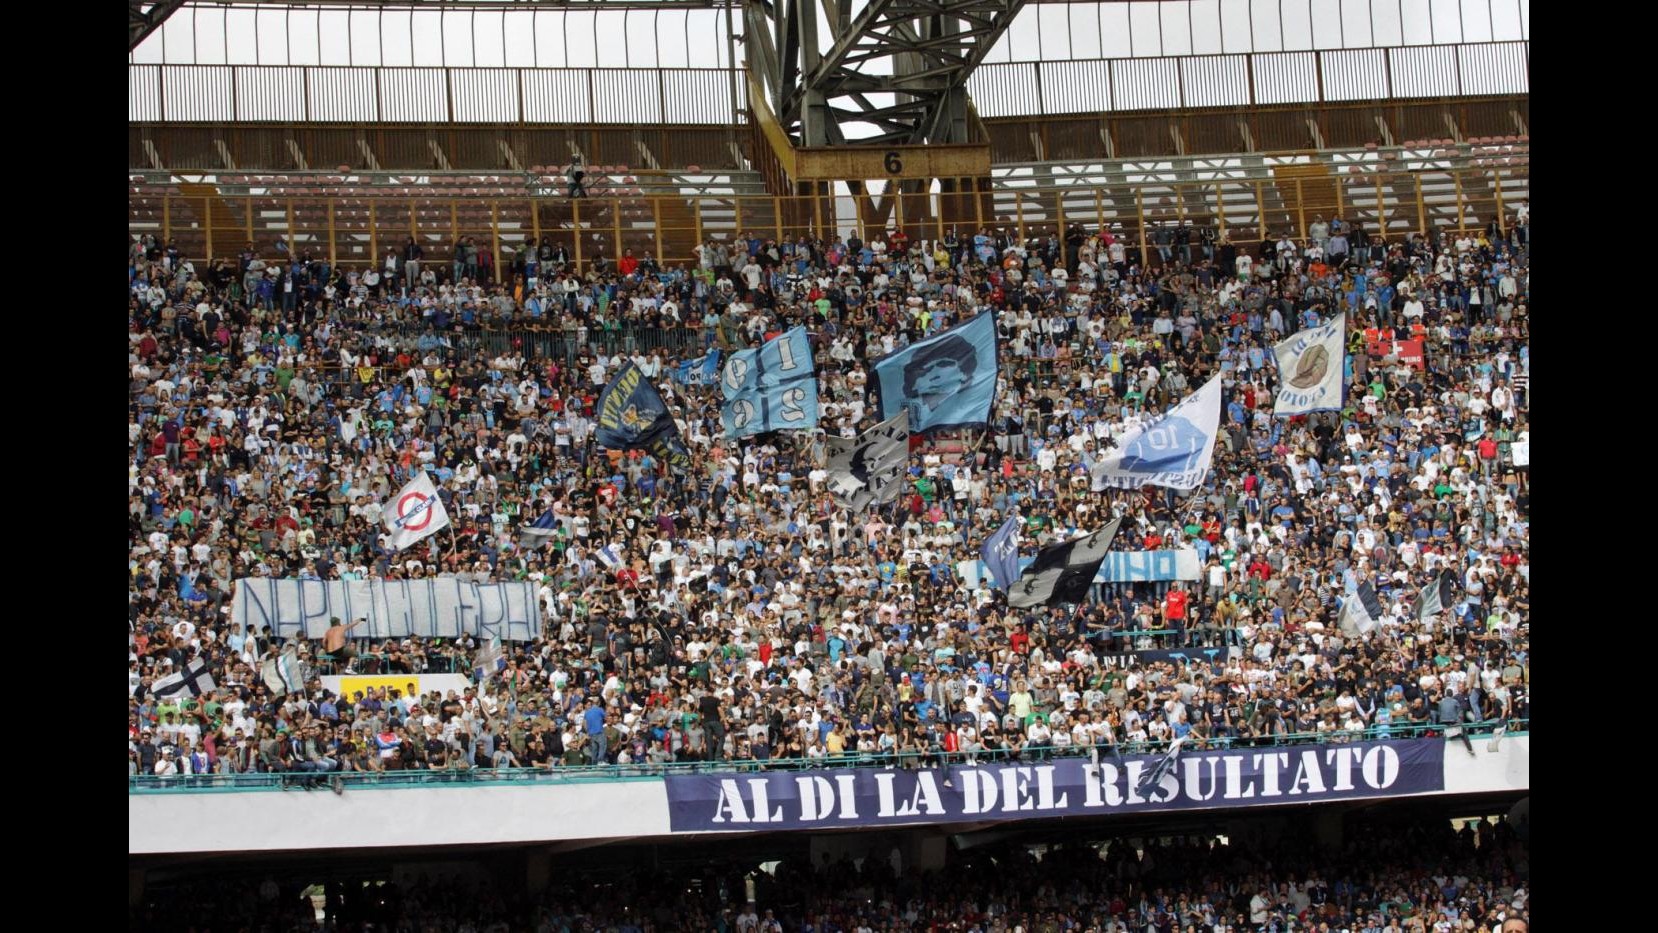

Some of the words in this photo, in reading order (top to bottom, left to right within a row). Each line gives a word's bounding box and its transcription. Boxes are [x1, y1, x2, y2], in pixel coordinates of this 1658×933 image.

[884, 151, 902, 174] 6
[712, 778, 784, 823] AL
[795, 774, 859, 821] DI
[874, 771, 946, 816] LA
[959, 764, 1067, 814] DEL
[1082, 744, 1400, 807] RISULTATO
